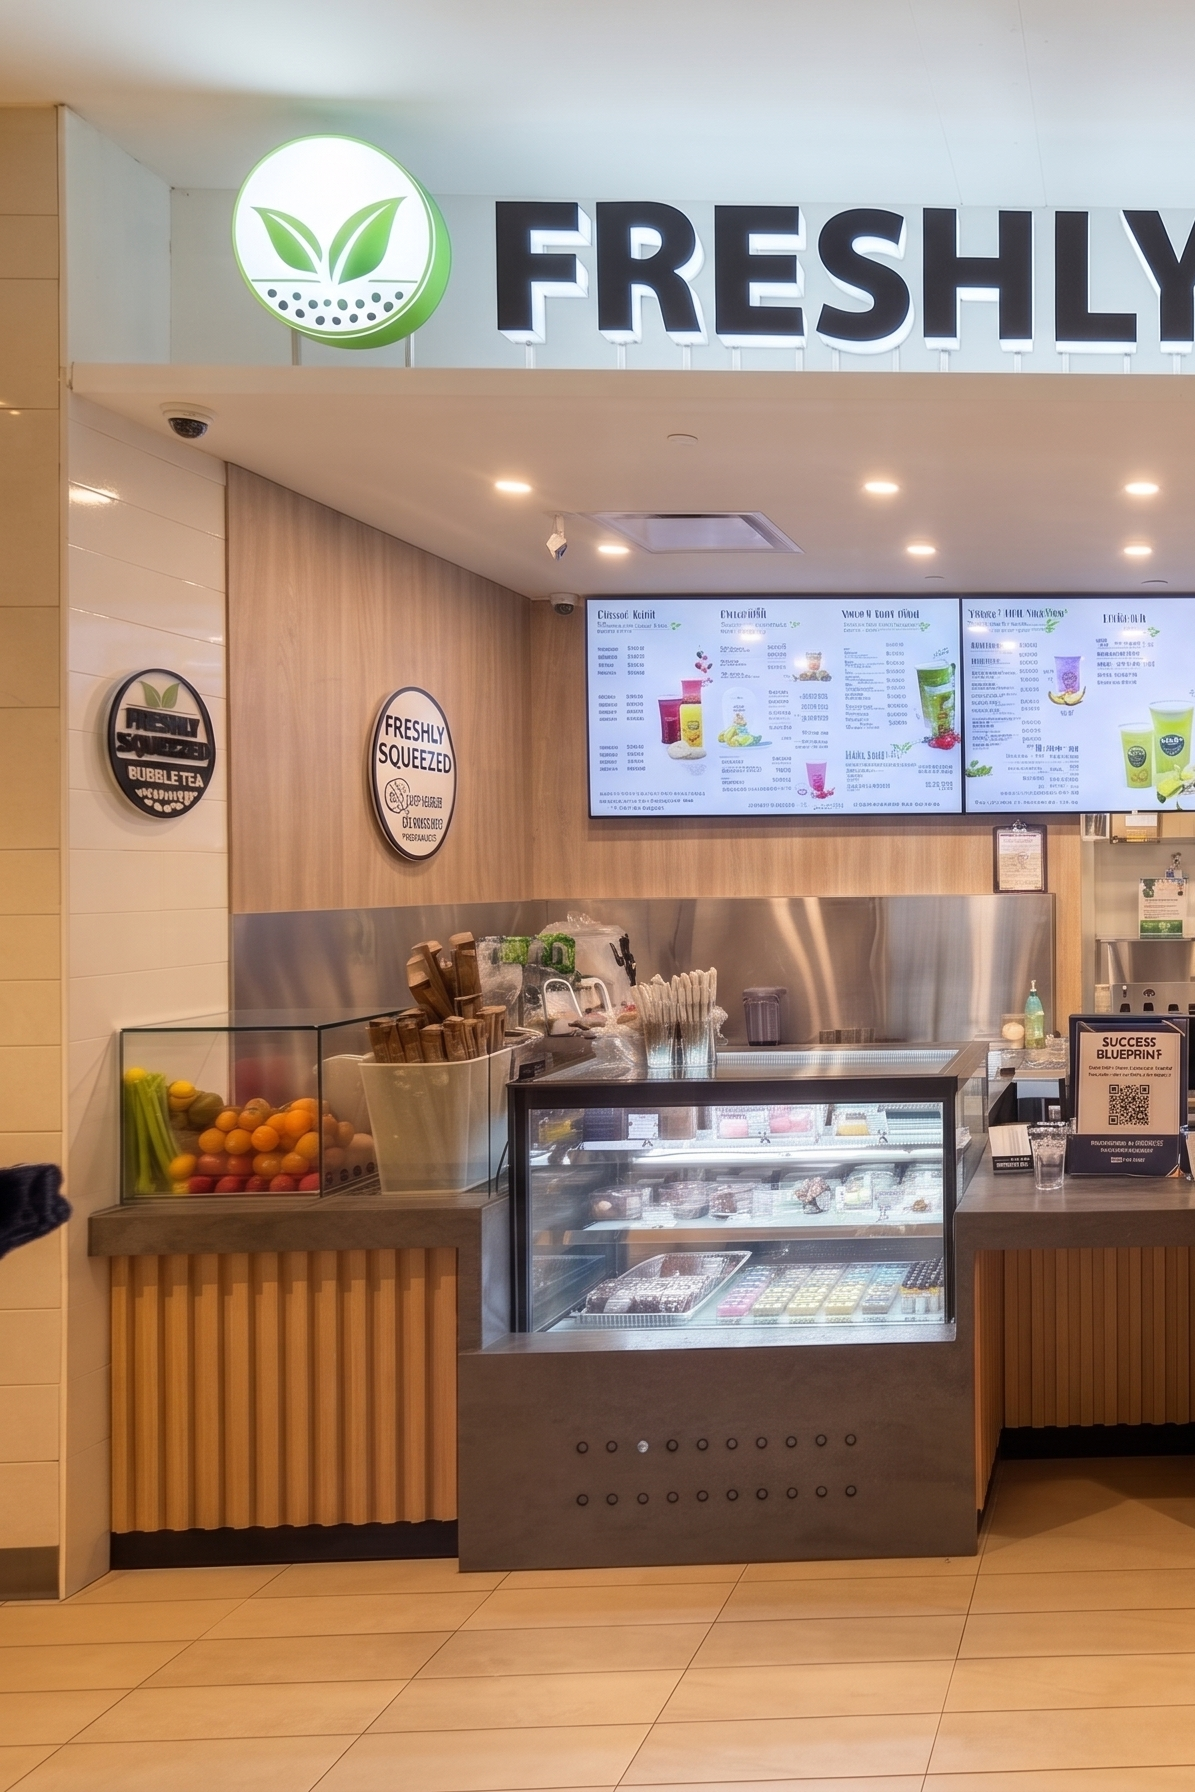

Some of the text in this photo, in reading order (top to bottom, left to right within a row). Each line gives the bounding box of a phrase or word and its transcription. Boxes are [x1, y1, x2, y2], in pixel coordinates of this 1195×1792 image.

[385, 714, 445, 745] FRESHLY
[378, 742, 452, 774] SQUEEZED
[127, 765, 204, 788] BUBBLE TEA
[1102, 1036, 1157, 1048] SUCCESS
